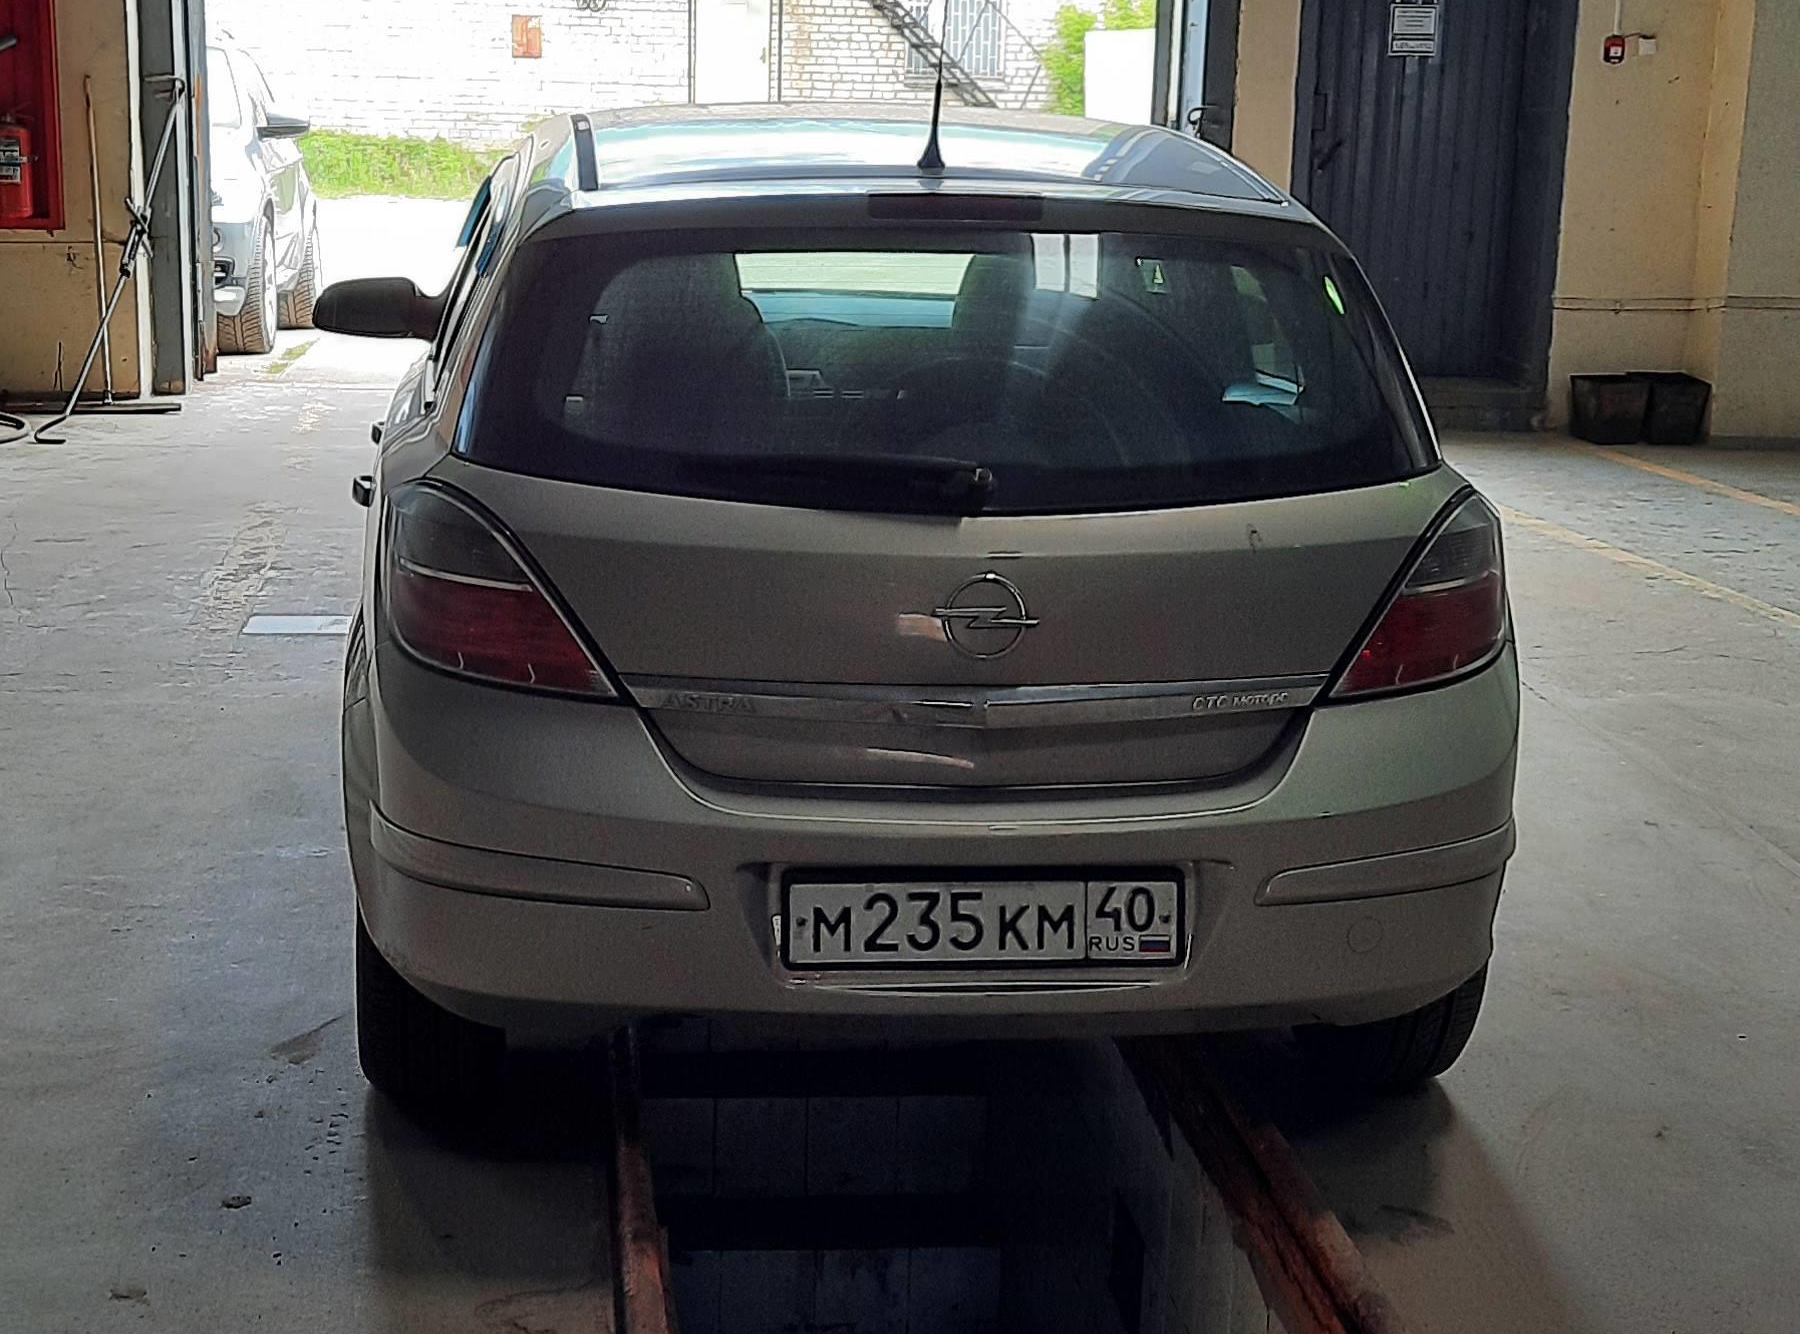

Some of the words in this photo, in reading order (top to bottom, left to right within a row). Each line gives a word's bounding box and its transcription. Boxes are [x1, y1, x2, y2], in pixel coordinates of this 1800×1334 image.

[660, 693, 757, 714] ASTRA
[811, 890, 1077, 954] М235КМ
[1094, 886, 1157, 933] 40
[1088, 936, 1136, 952] RUS
